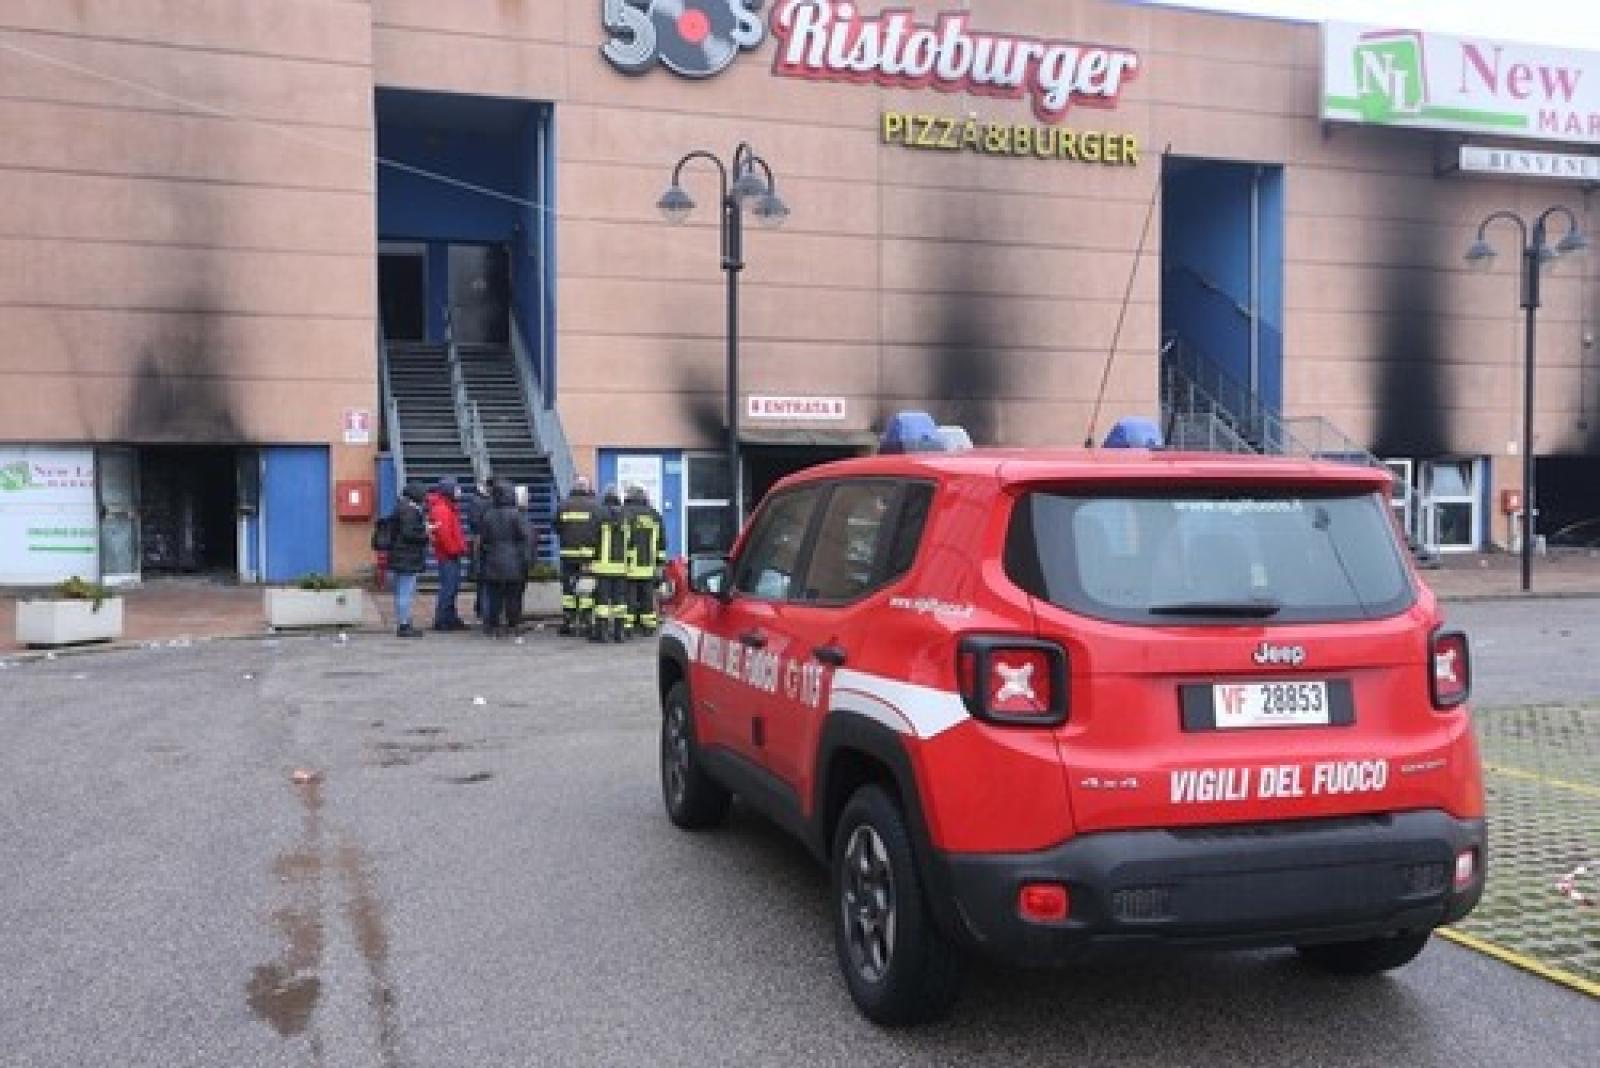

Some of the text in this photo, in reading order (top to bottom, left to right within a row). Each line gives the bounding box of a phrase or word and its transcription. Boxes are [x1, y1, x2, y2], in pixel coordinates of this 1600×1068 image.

[777, 0, 1138, 115] Ristoburger
[1458, 42, 1583, 103] New
[1252, 642, 1305, 666] Jeep
[1221, 684, 1323, 714] VF 28853
[1169, 758, 1389, 804] VIGILI DEL FUOCO
